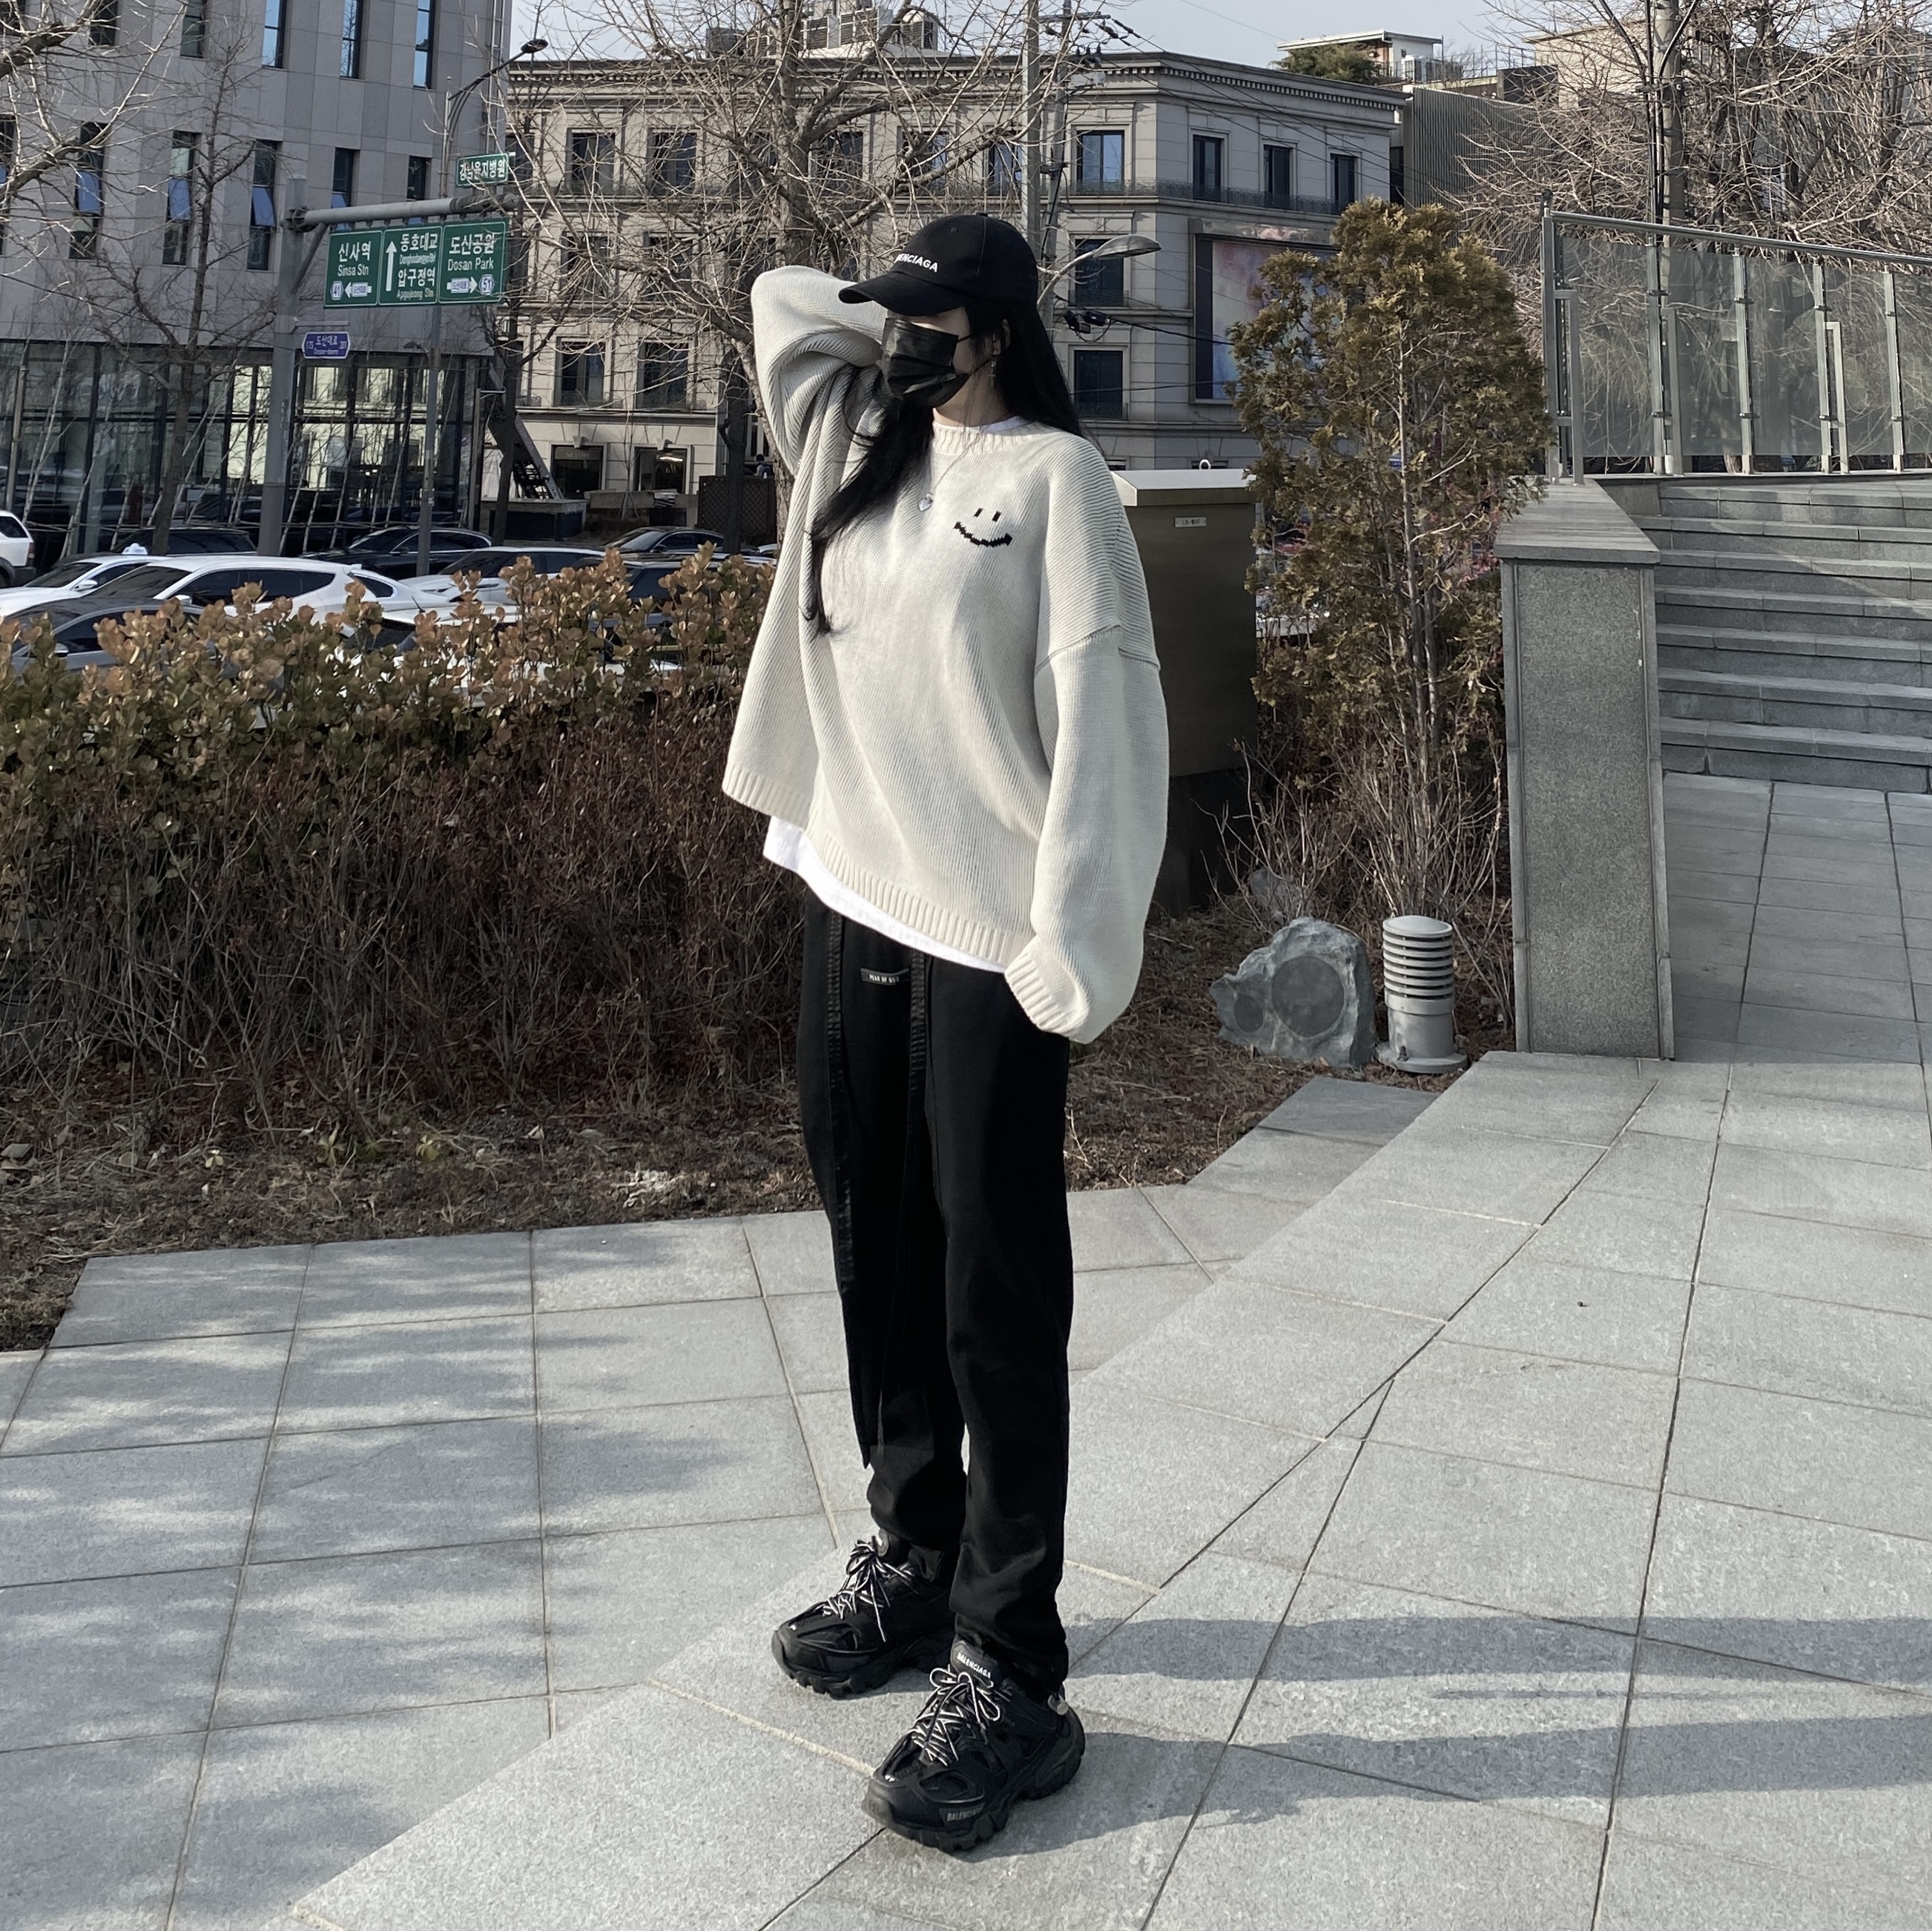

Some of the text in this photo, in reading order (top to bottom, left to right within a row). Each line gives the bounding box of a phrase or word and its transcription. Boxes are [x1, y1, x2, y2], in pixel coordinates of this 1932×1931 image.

[400, 232, 438, 252] 동호대교
[449, 234, 495, 255] 도산공원
[338, 241, 371, 263] 신사역
[337, 263, 369, 277] Sinsa Stn
[447, 257, 494, 271] Dosan Park
[398, 267, 436, 288] 압구정역
[482, 278, 492, 292] 51
[315, 334, 338, 347] 도산대로
